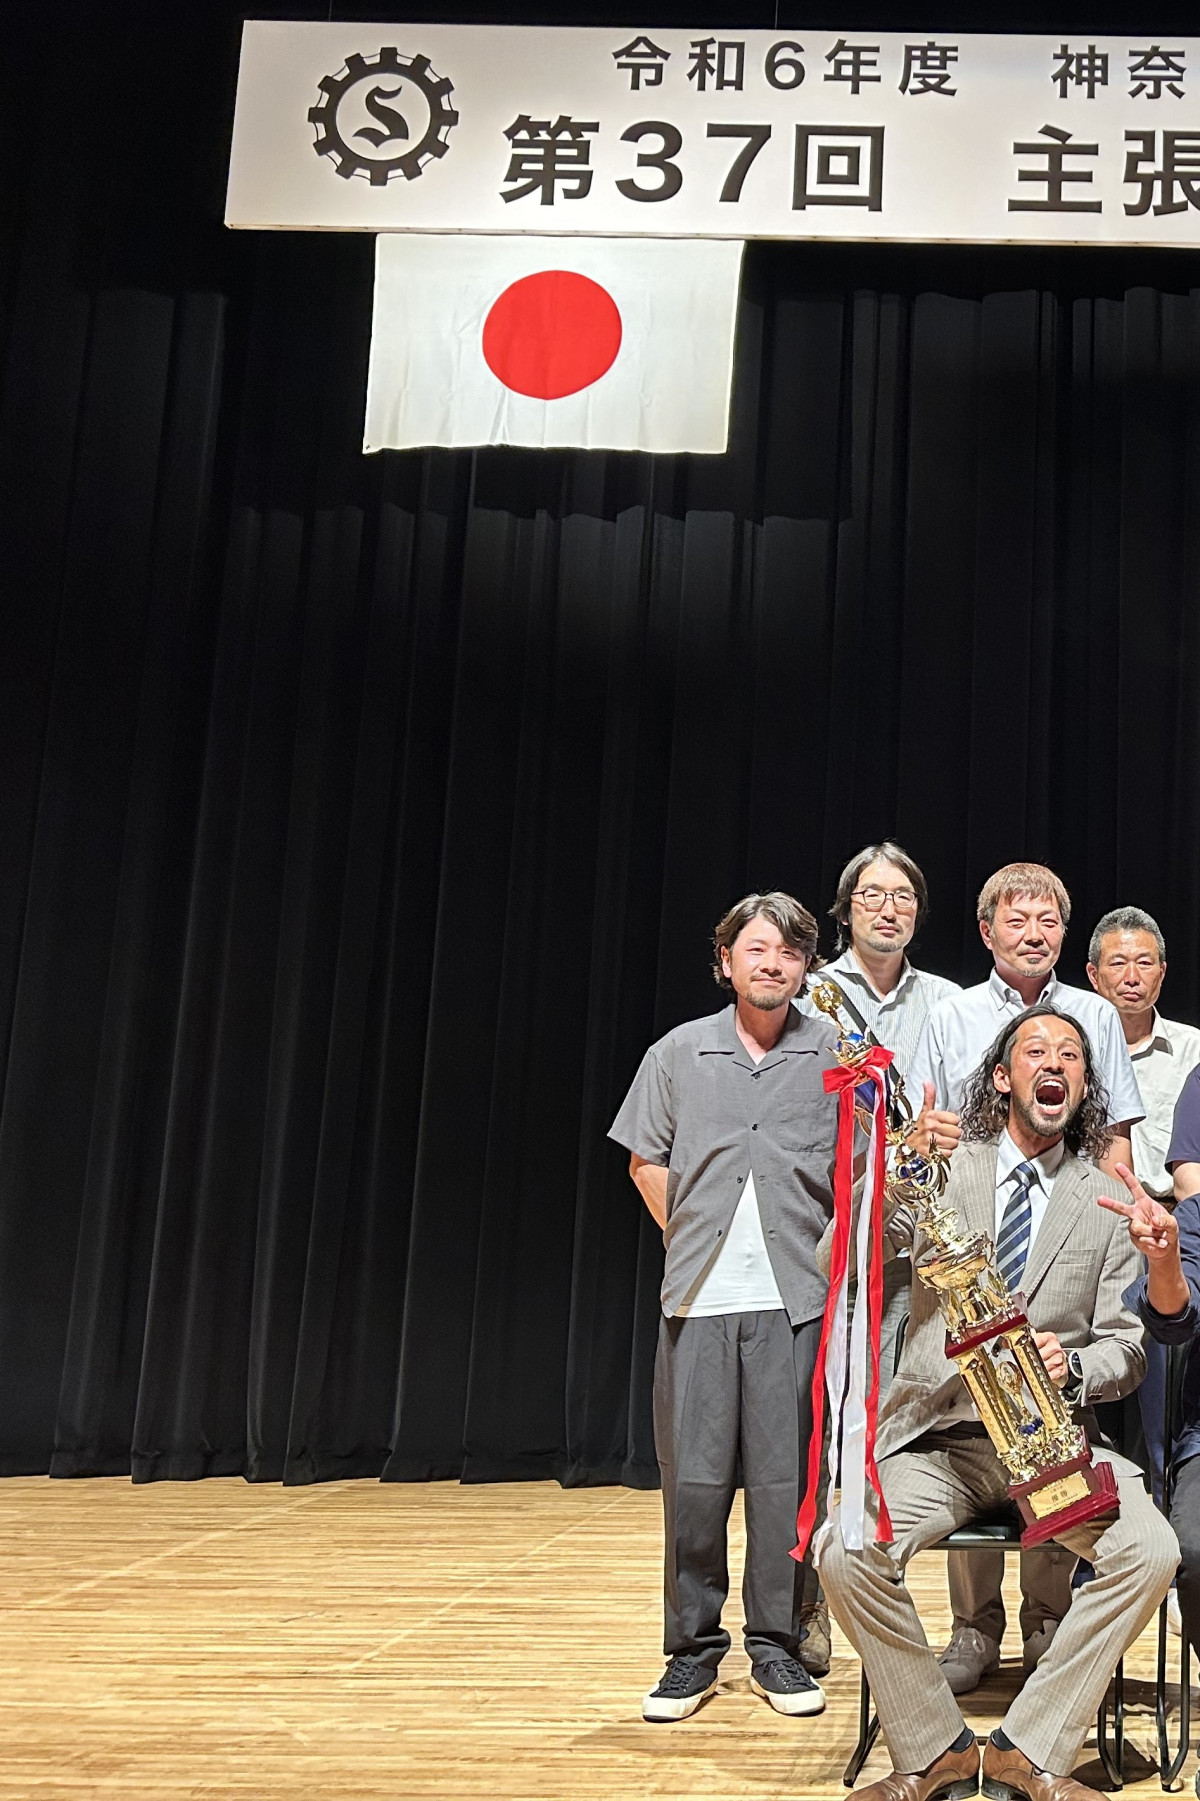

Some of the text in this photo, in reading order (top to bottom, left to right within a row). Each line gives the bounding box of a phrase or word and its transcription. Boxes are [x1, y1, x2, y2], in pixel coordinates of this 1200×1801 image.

[611, 36, 959, 97] 令和6年度
[499, 114, 886, 212] 第37回
